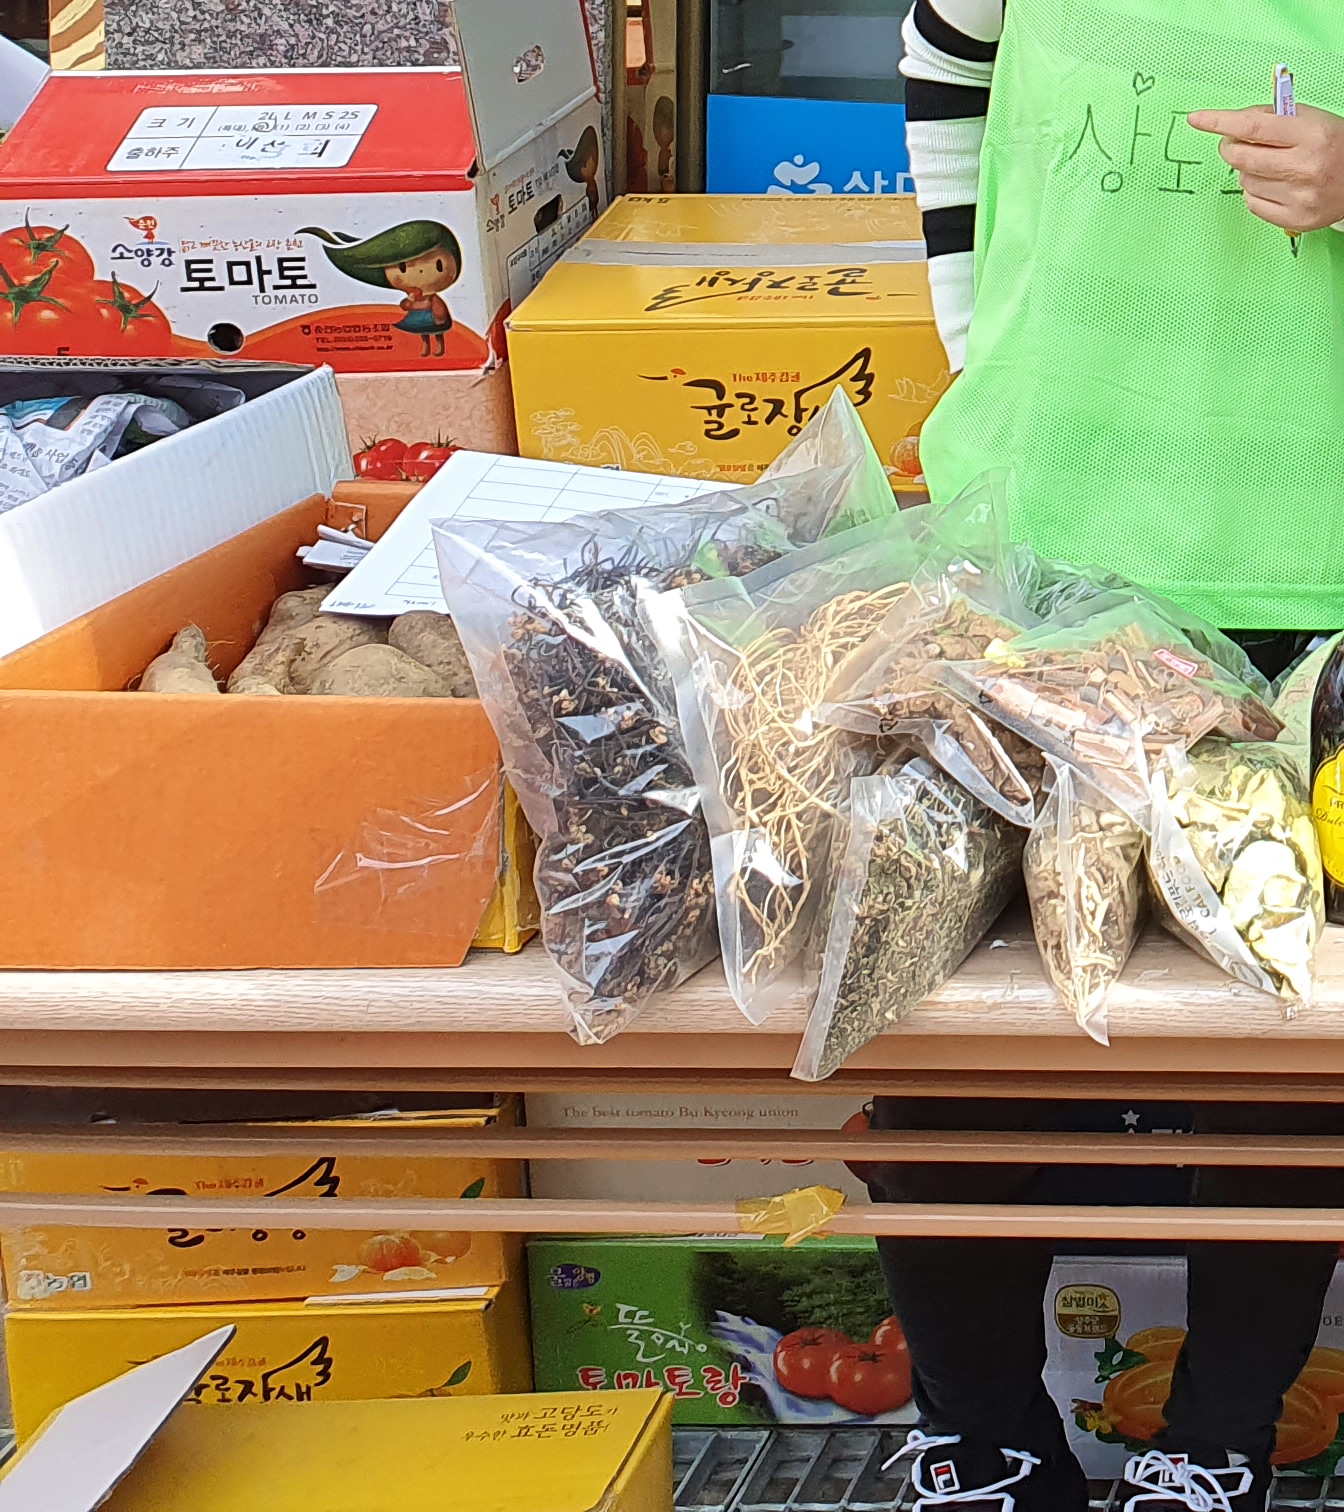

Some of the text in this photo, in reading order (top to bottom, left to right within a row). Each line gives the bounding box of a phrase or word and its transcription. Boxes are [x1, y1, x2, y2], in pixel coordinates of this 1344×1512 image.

[302, 111, 317, 121] M
[508, 181, 535, 215] 토마토
[110, 243, 176, 267] 소양강
[180, 255, 317, 293] 토마토
[252, 293, 319, 305] TOMATO
[732, 372, 753, 383] The
[562, 1105, 587, 1119] The
[626, 1105, 674, 1119] tomato
[679, 1105, 700, 1119] Bu
[703, 1104, 754, 1122] Kyeong
[758, 1105, 800, 1119] union
[578, 1362, 749, 1407] 토마토랑
